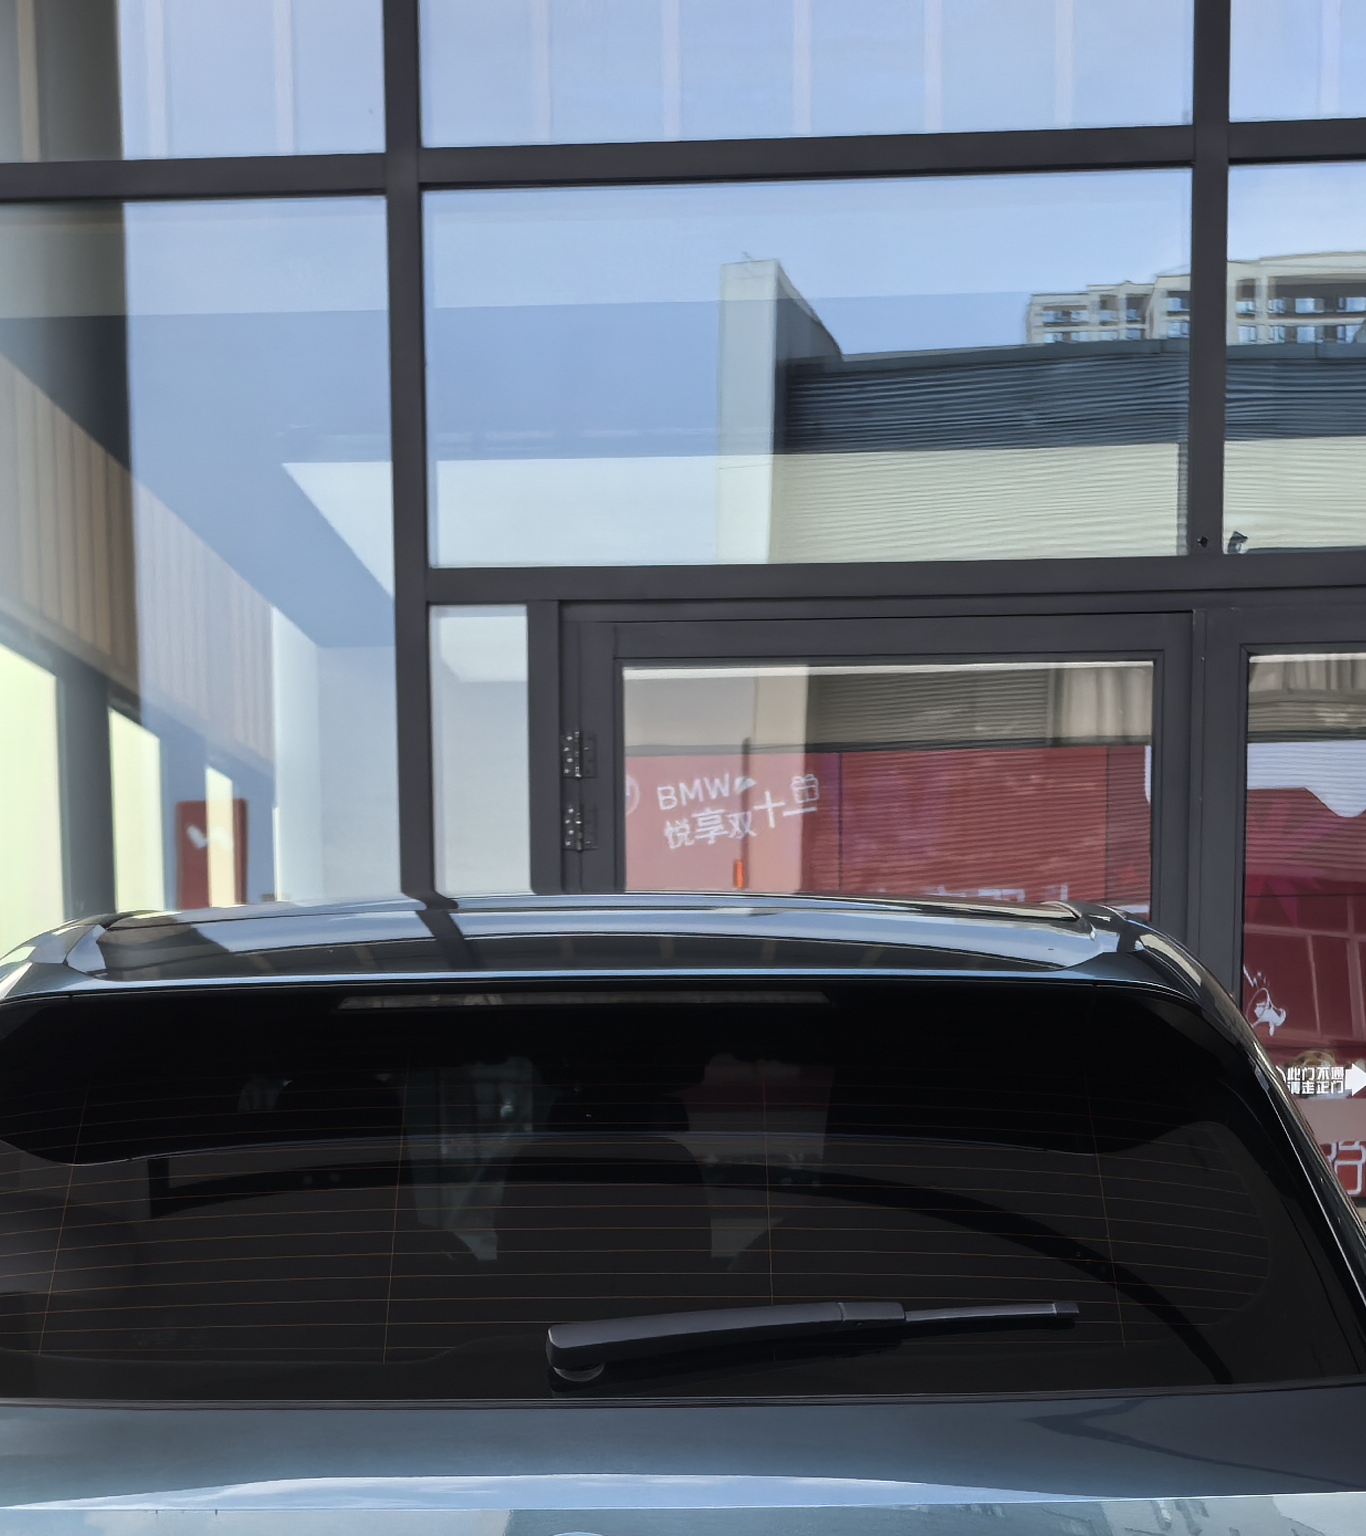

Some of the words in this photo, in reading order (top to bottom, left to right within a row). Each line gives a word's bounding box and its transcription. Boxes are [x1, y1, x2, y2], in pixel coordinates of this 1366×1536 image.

[657, 773, 730, 811] BMW
[664, 790, 818, 850] 悦享双十一
